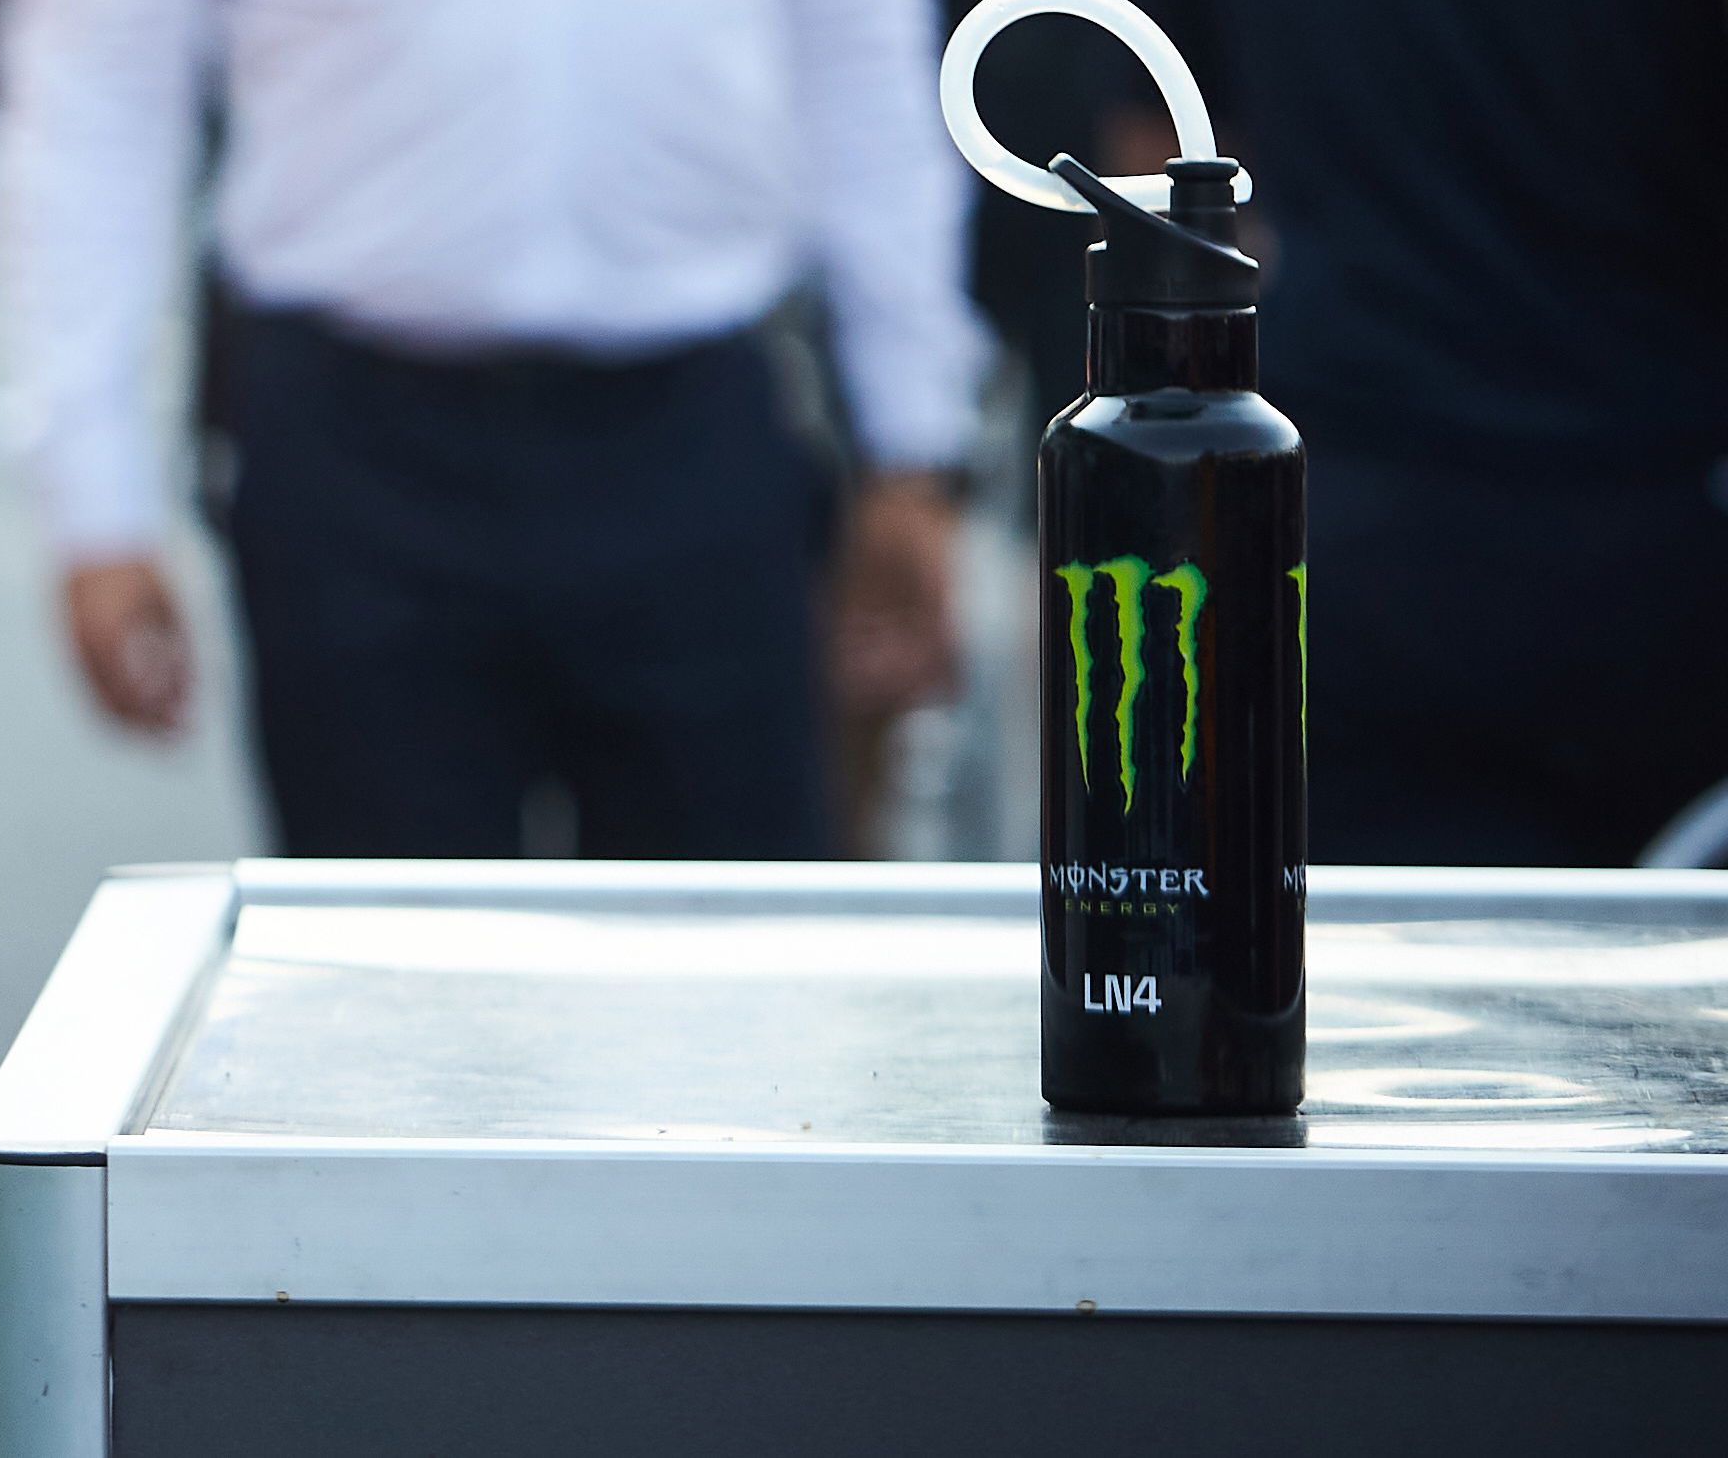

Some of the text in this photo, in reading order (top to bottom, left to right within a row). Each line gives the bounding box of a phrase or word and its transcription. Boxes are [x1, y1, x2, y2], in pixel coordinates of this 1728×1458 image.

[1050, 860, 1210, 897] MONSTER
[1065, 900, 1180, 915] ENERGY
[1084, 973, 1162, 1014] LN4
